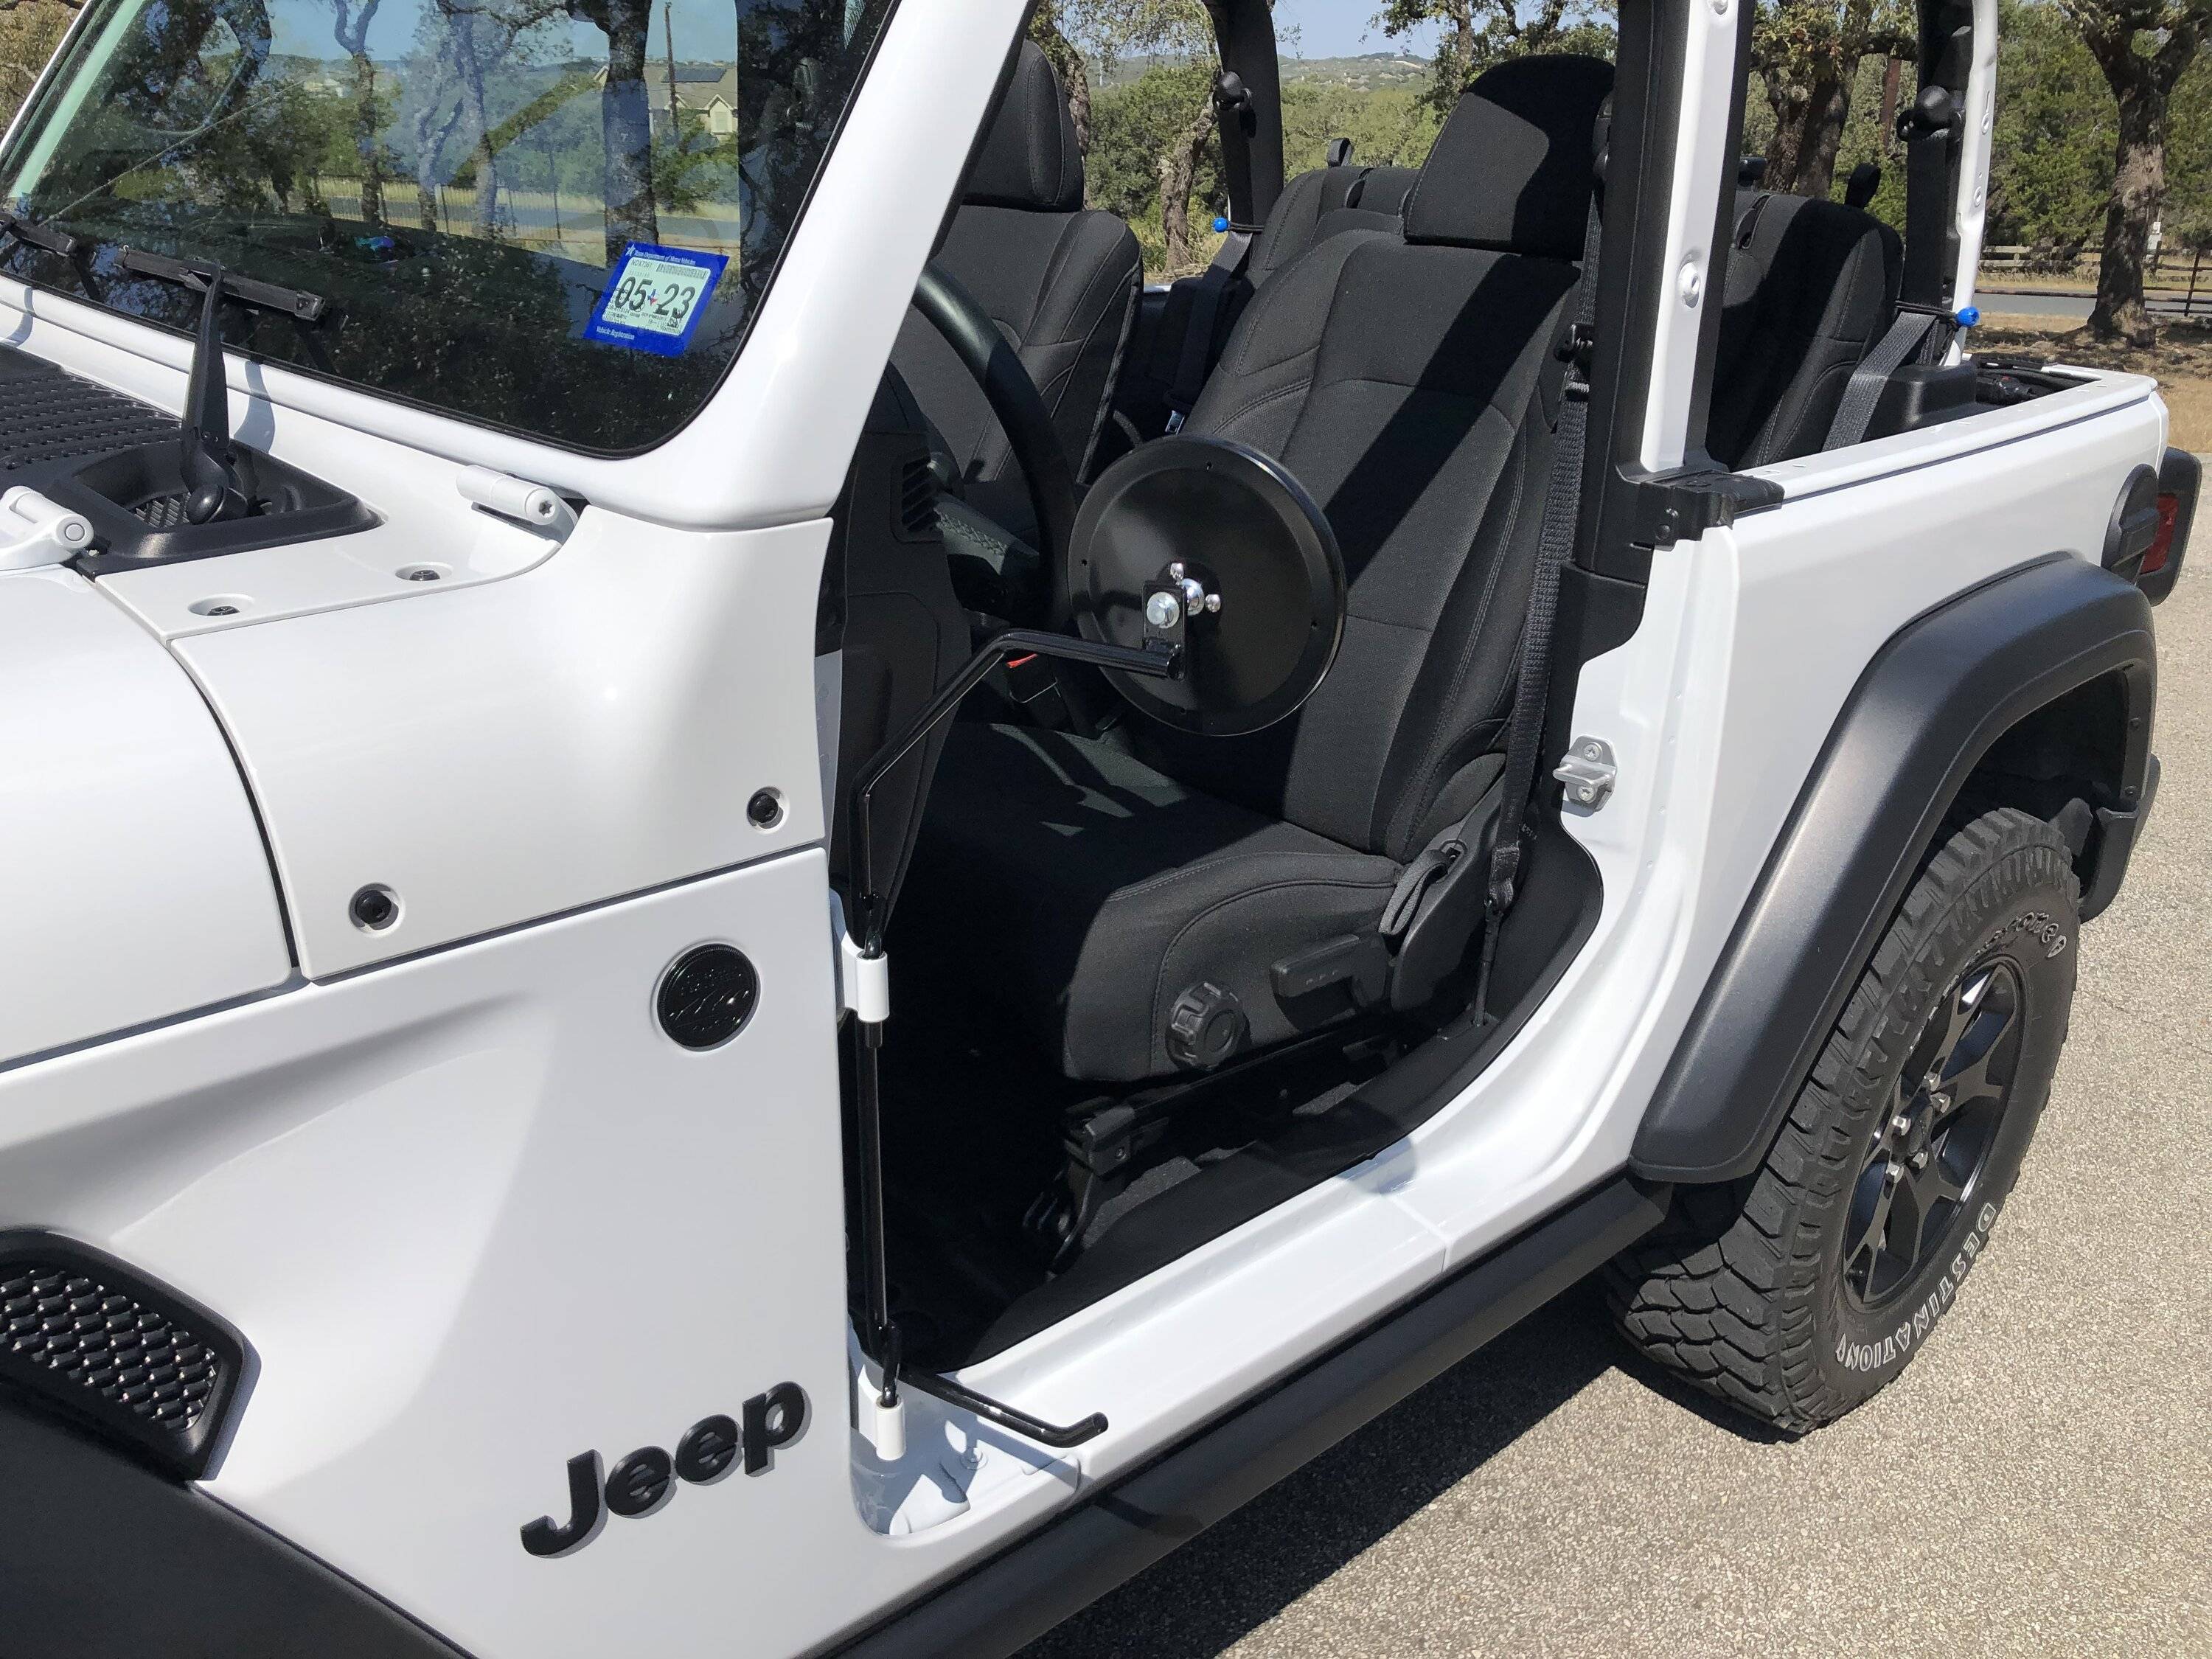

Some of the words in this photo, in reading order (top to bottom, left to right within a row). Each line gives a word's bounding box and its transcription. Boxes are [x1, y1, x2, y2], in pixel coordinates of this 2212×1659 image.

[614, 276, 653, 313] 05
[653, 282, 696, 319] 23
[1845, 1201, 1997, 1372] DESTINATION
[520, 1380, 810, 1557] Jeep
